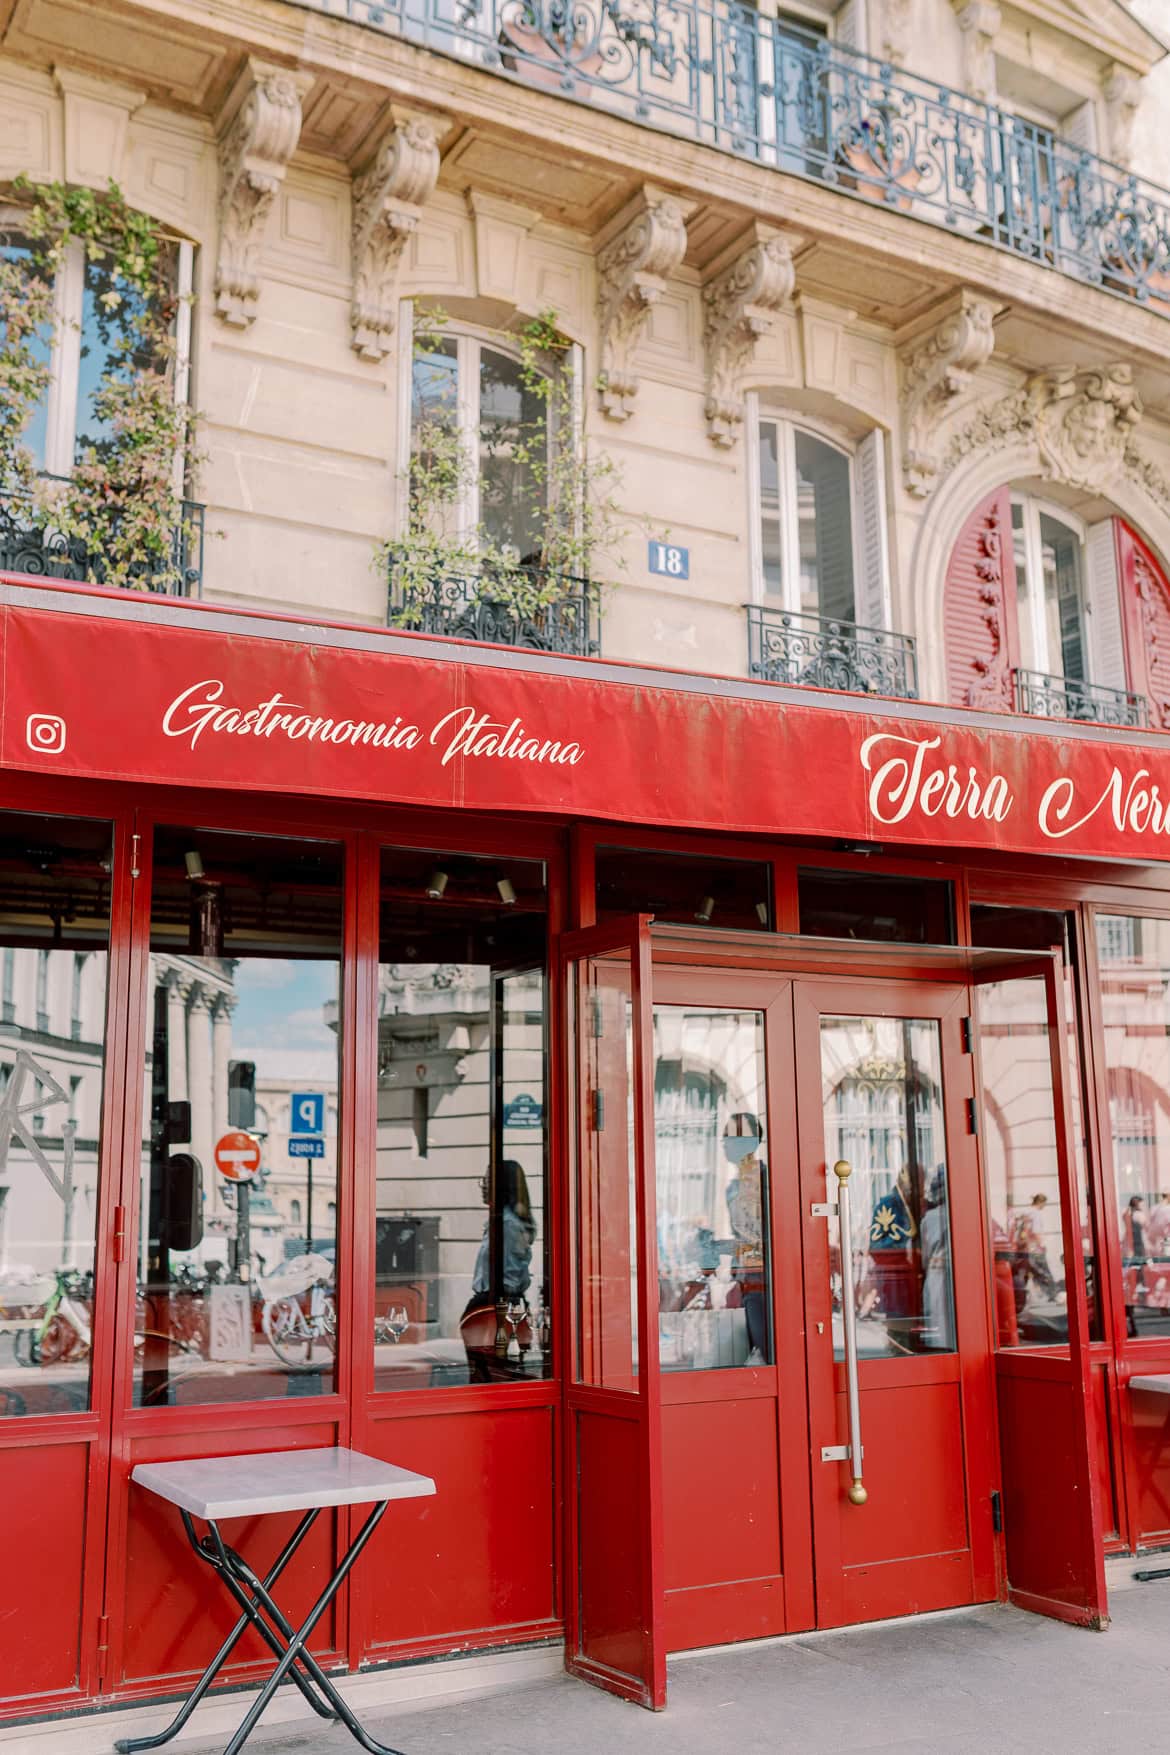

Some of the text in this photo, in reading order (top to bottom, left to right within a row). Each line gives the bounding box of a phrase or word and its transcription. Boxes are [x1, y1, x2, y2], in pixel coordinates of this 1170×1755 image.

[657, 546, 682, 574] 18
[162, 679, 585, 767] Gastronomia Italiana
[860, 733, 1170, 838] Terra Ner
